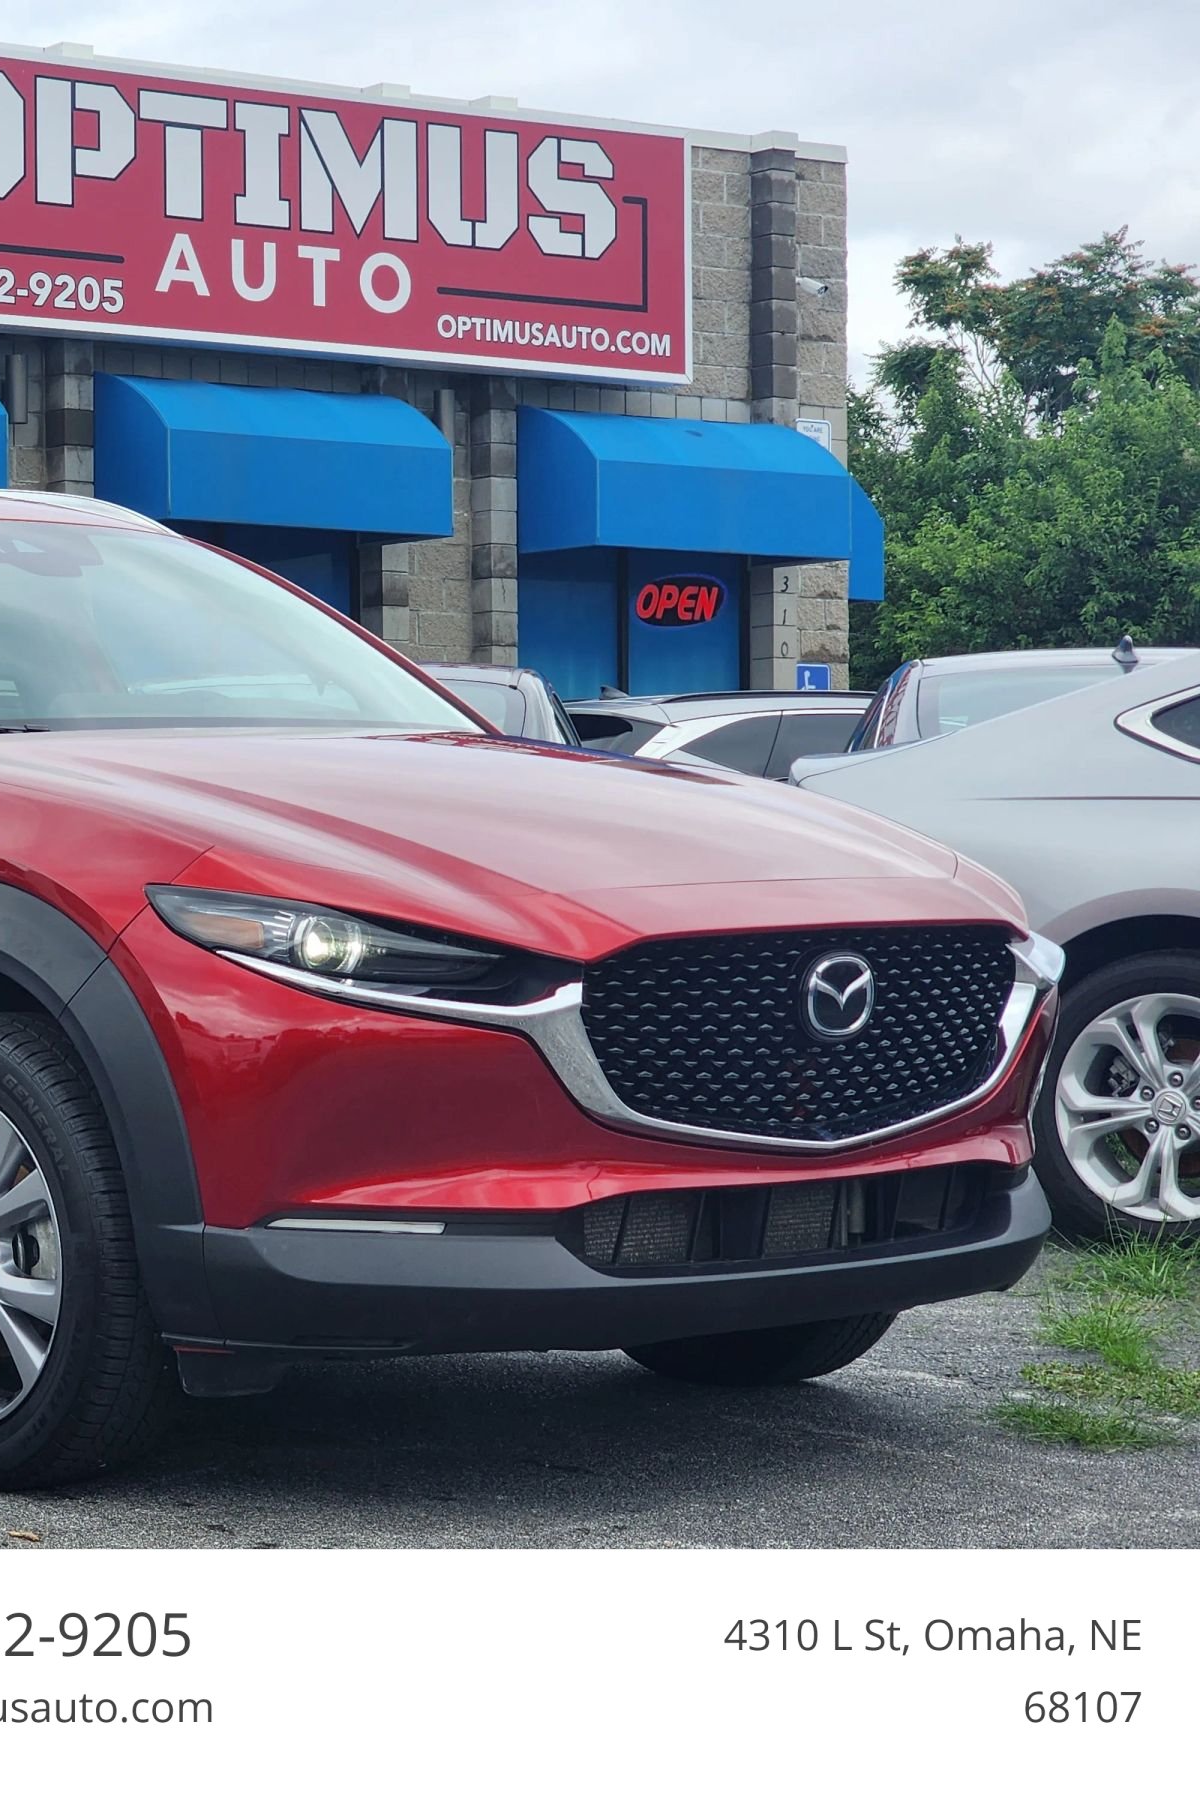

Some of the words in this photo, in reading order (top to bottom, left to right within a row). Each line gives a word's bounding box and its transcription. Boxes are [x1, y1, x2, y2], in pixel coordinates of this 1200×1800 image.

[154, 231, 414, 315] AUTO
[436, 314, 672, 357] OPTIMUSAUTO.COM
[635, 583, 719, 622] OPEN
[2, 1073, 70, 1177] GENERAL
